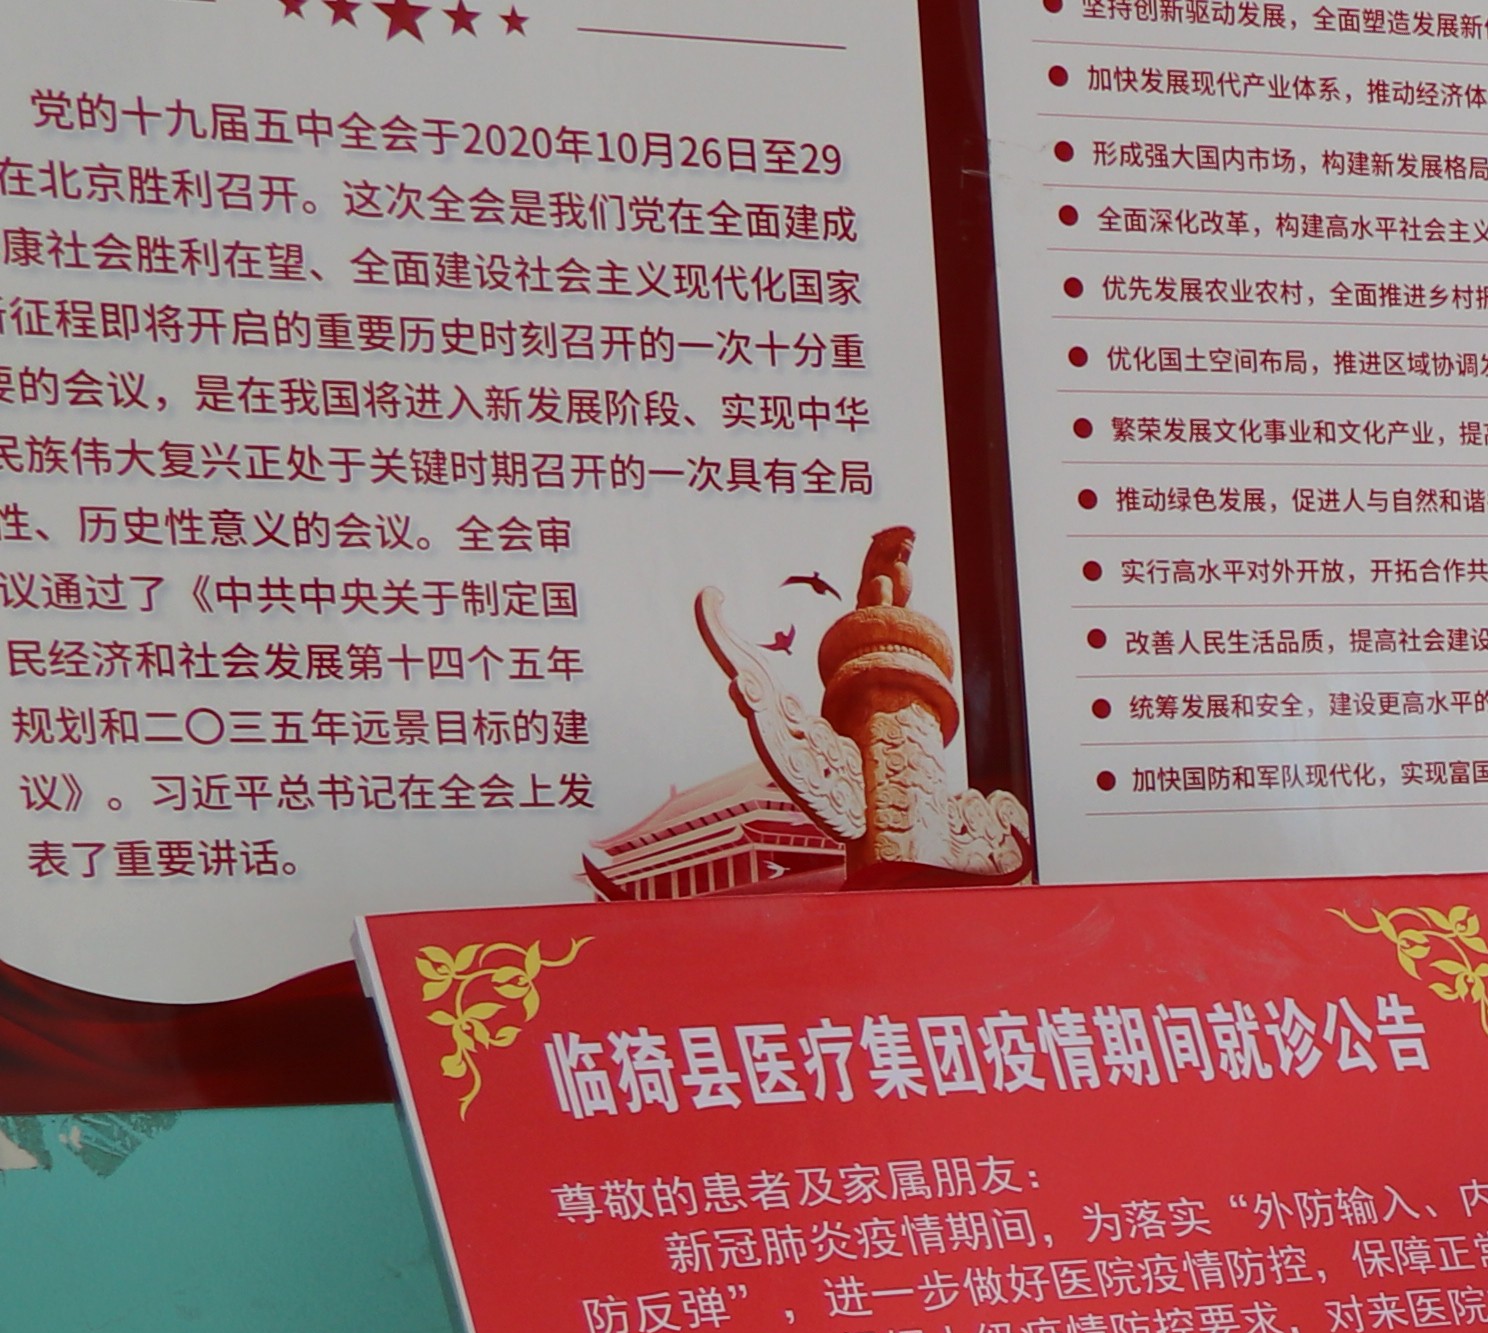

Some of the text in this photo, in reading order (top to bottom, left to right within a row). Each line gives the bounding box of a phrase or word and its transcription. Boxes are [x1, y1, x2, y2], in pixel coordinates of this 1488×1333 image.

[544, 993, 1432, 1119] 临猗县医疗集团疫情期间就诊公告
[551, 1155, 1039, 1223] 尊敬的患者及家属朋友：
